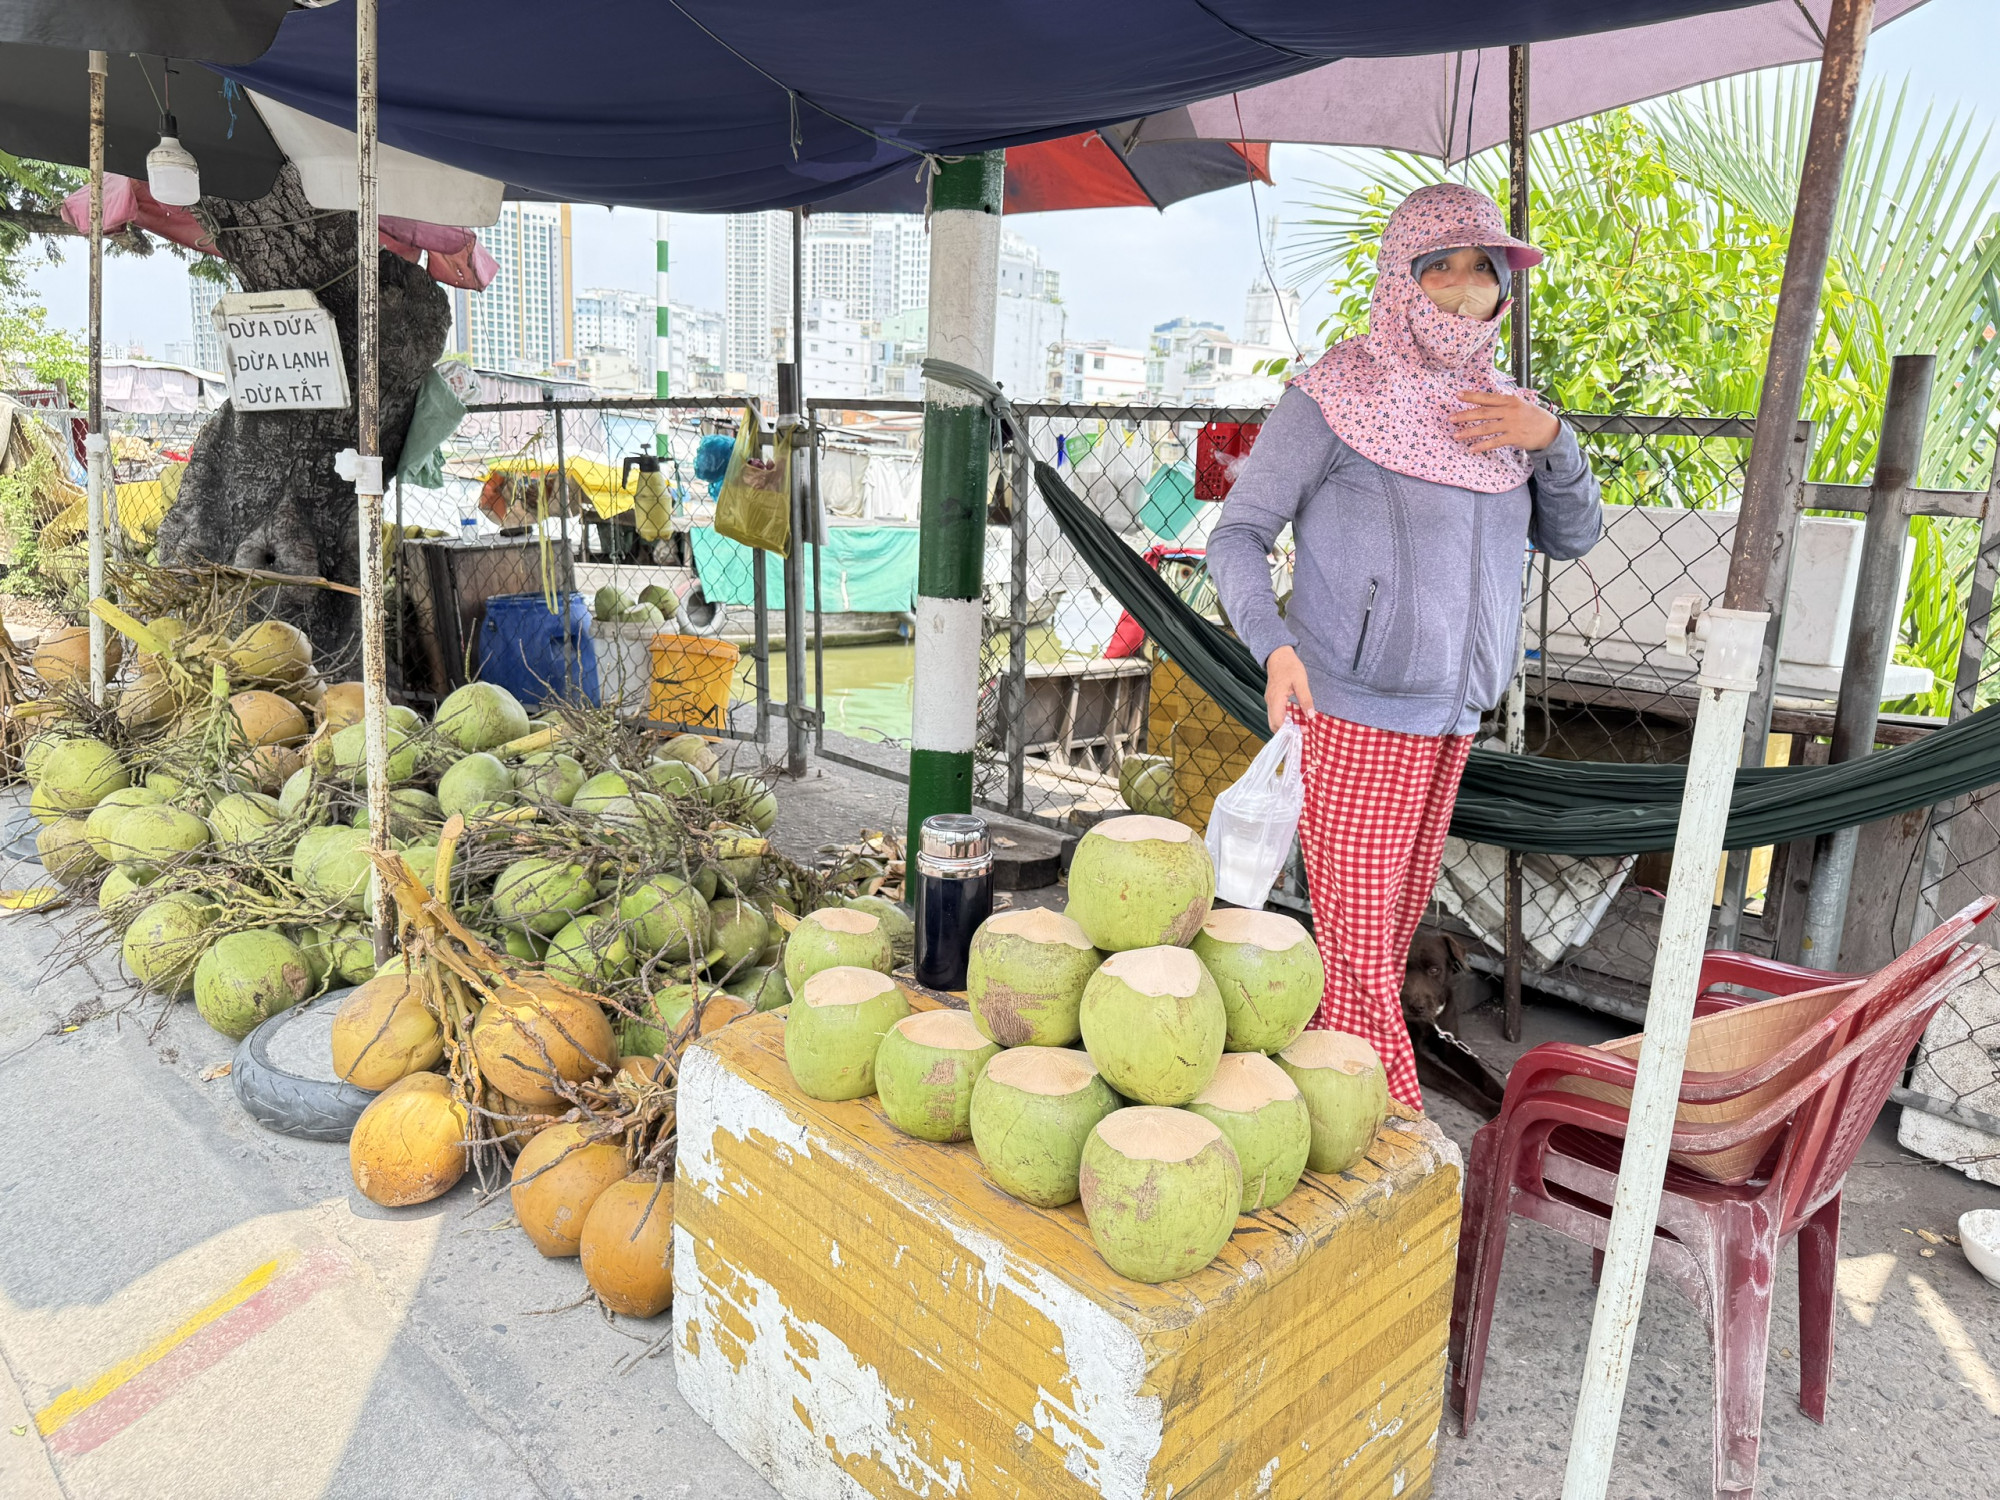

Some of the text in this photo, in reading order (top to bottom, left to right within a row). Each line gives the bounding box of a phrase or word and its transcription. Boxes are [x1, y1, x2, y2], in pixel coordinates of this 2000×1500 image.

[228, 315, 317, 339] DỪA DỨA
[283, 351, 330, 373] LẠNH
